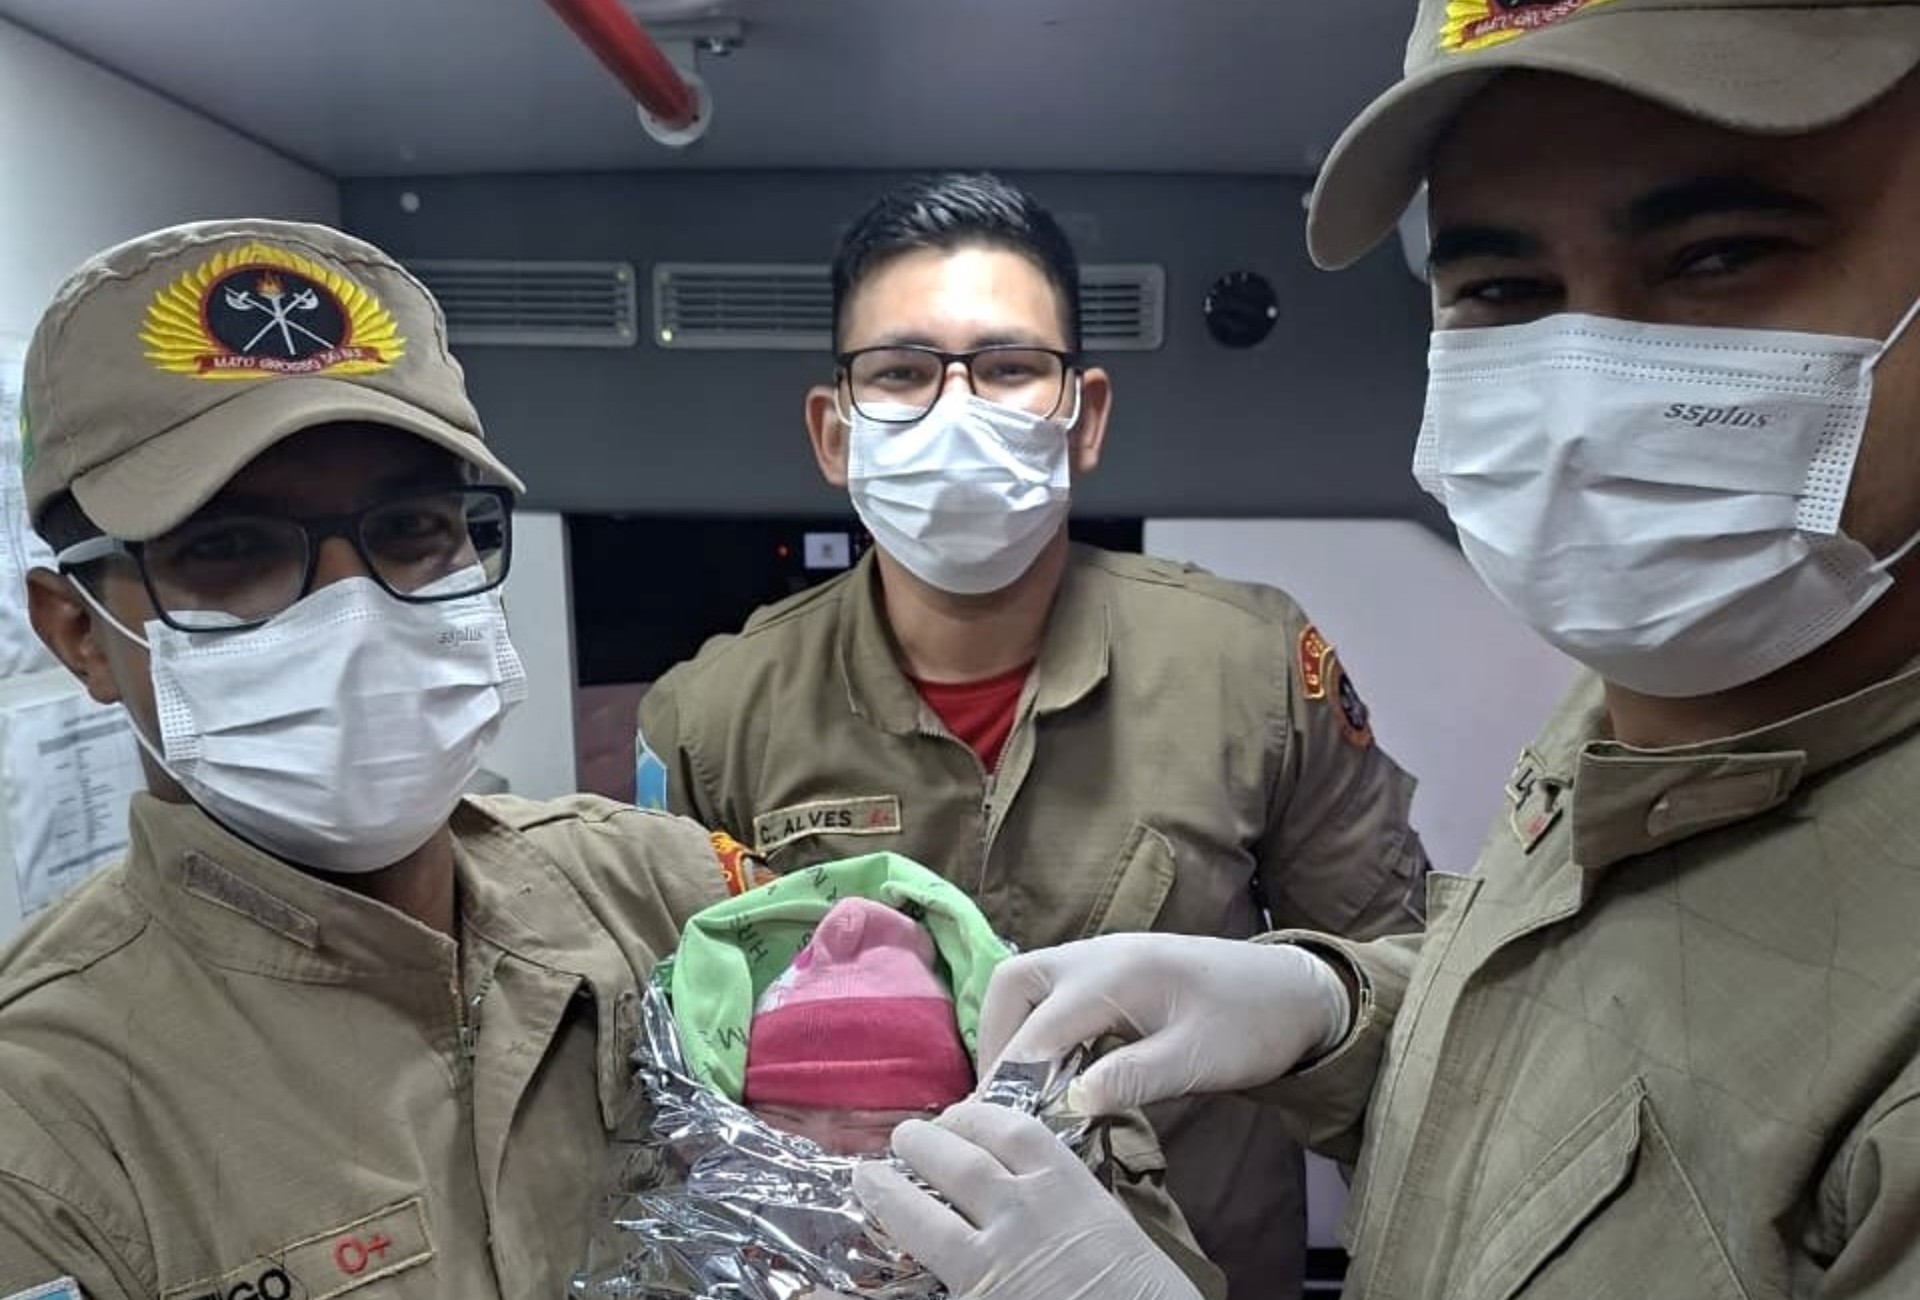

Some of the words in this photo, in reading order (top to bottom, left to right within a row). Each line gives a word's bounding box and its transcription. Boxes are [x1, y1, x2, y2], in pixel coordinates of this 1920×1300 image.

[1663, 403, 1771, 428] ssplus
[760, 825, 778, 843] C.
[784, 810, 852, 837] ALVES
[334, 1233, 392, 1274] O+
